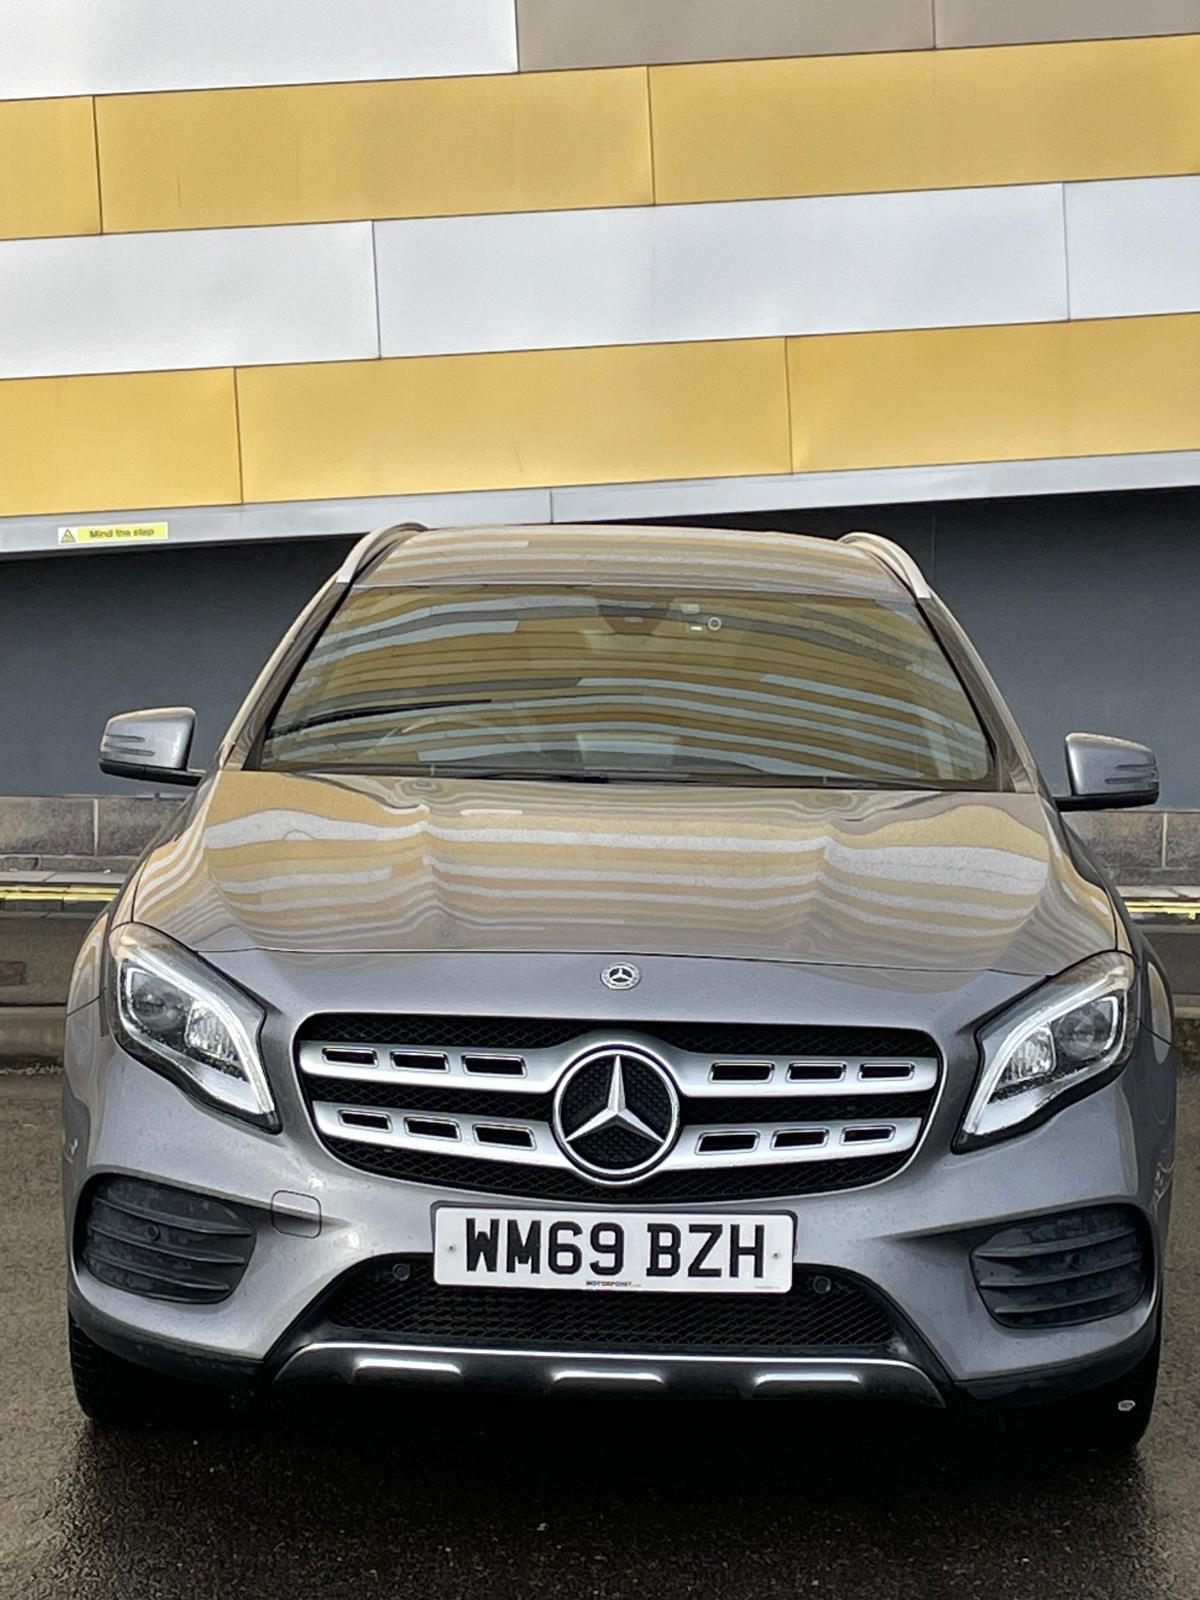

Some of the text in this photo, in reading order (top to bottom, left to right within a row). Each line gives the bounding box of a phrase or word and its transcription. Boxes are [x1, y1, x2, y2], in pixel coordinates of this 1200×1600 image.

[89, 528, 155, 538] Mind the step
[465, 1217, 766, 1279] WM69 BZH
